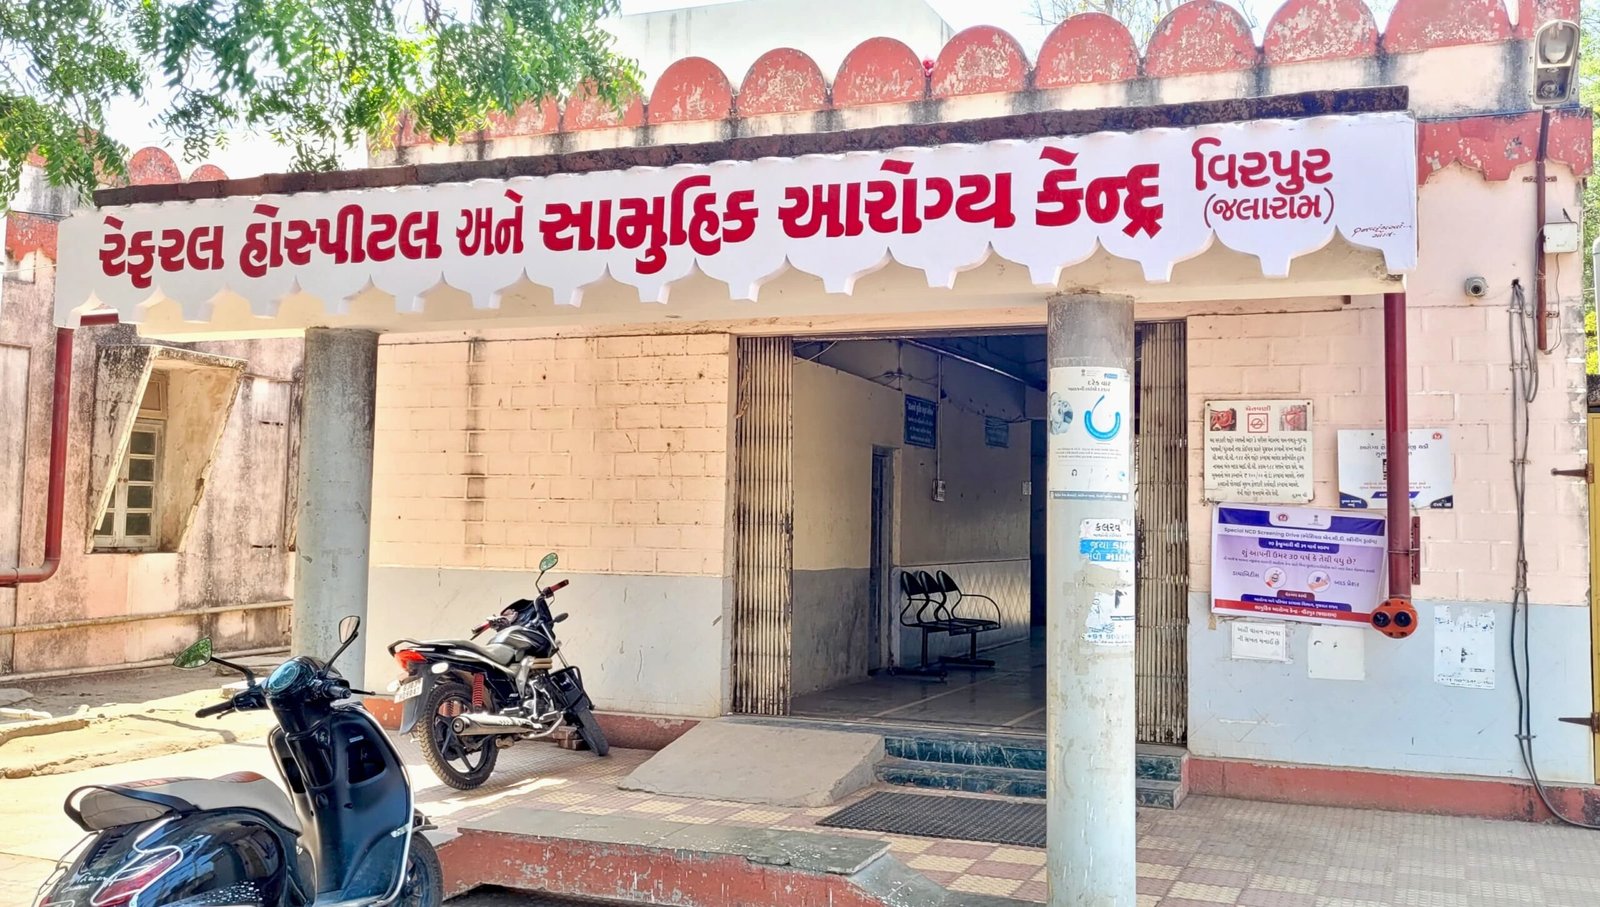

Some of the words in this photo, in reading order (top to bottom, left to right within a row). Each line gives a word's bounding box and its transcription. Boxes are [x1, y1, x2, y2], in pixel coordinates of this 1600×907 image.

[1191, 136, 1333, 195] વિરપુર
[99, 215, 224, 289] રેફરલ
[239, 203, 442, 278] હોસ્પીટલ
[456, 189, 524, 256] અને
[539, 175, 760, 275] સામુહિક
[778, 159, 1016, 239] આરોગ્ય
[1035, 146, 1164, 239] કેન્દ્ર
[1203, 187, 1335, 229] (જલારામ)
[1257, 530, 1285, 538] Screening
